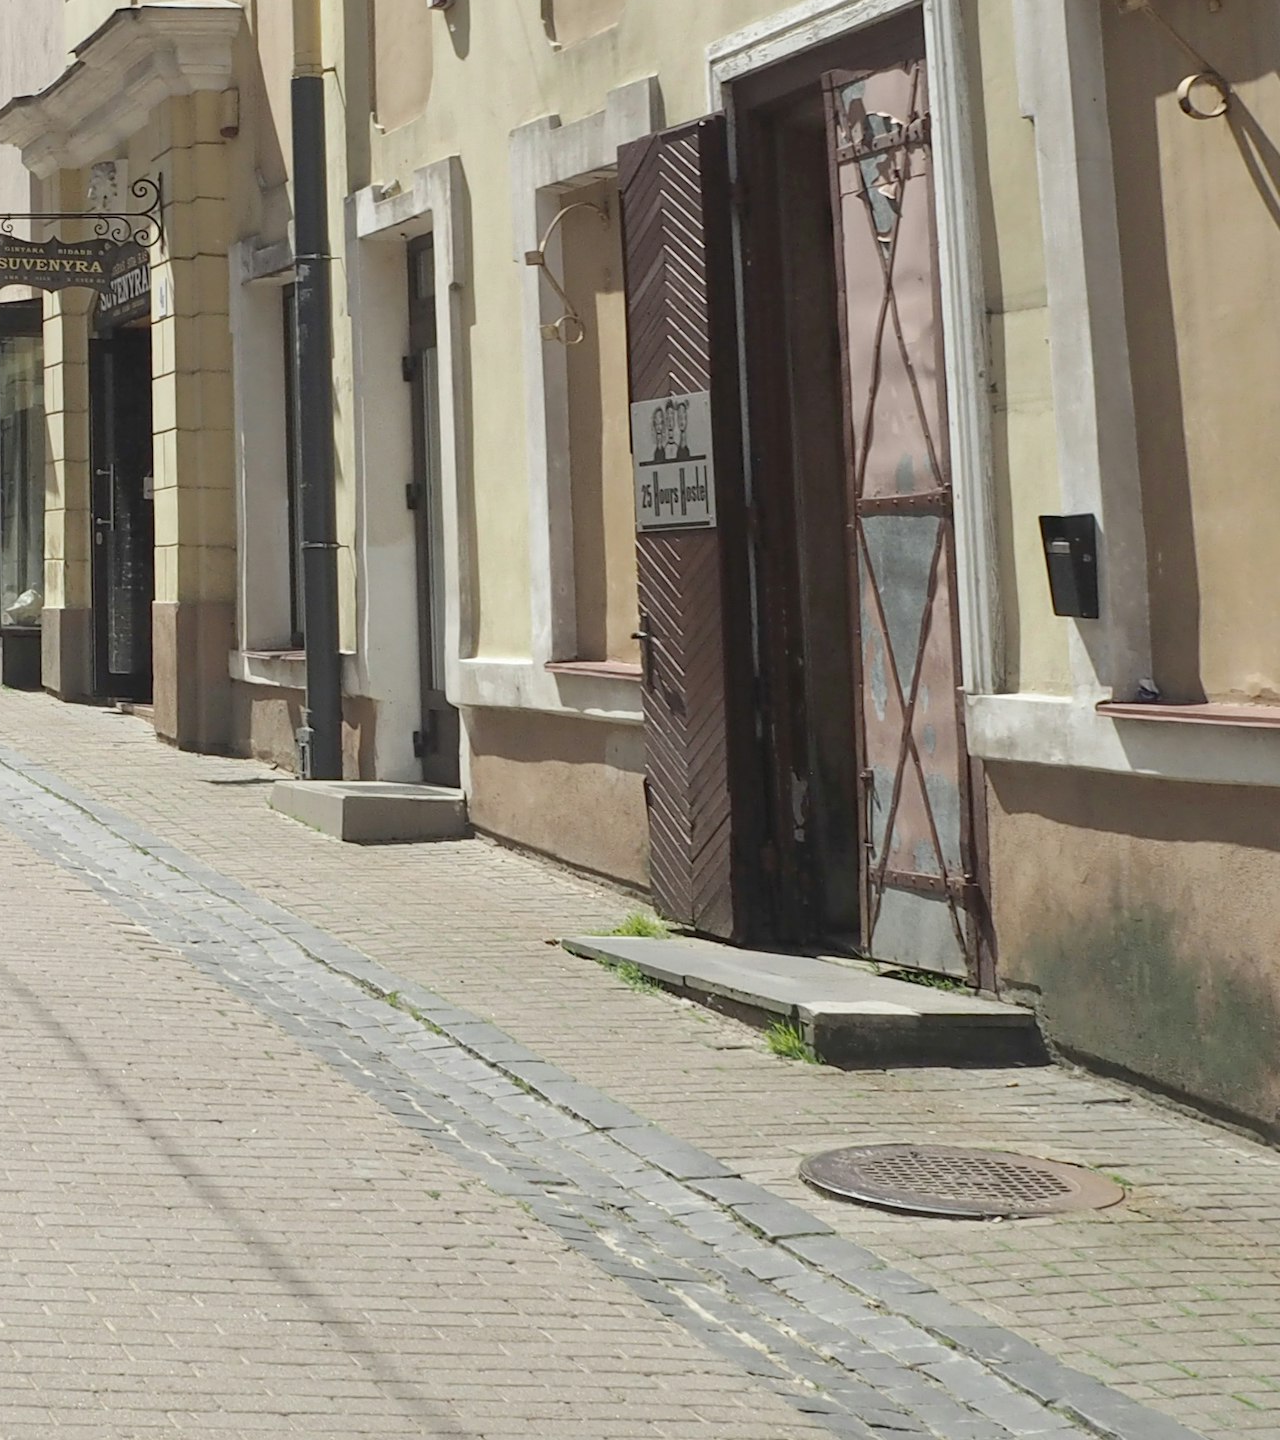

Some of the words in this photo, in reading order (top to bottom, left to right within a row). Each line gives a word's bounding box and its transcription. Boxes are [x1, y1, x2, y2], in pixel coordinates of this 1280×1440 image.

[641, 484, 653, 509] 25
[653, 471, 679, 517] Hours
[679, 465, 710, 517] Hostel
